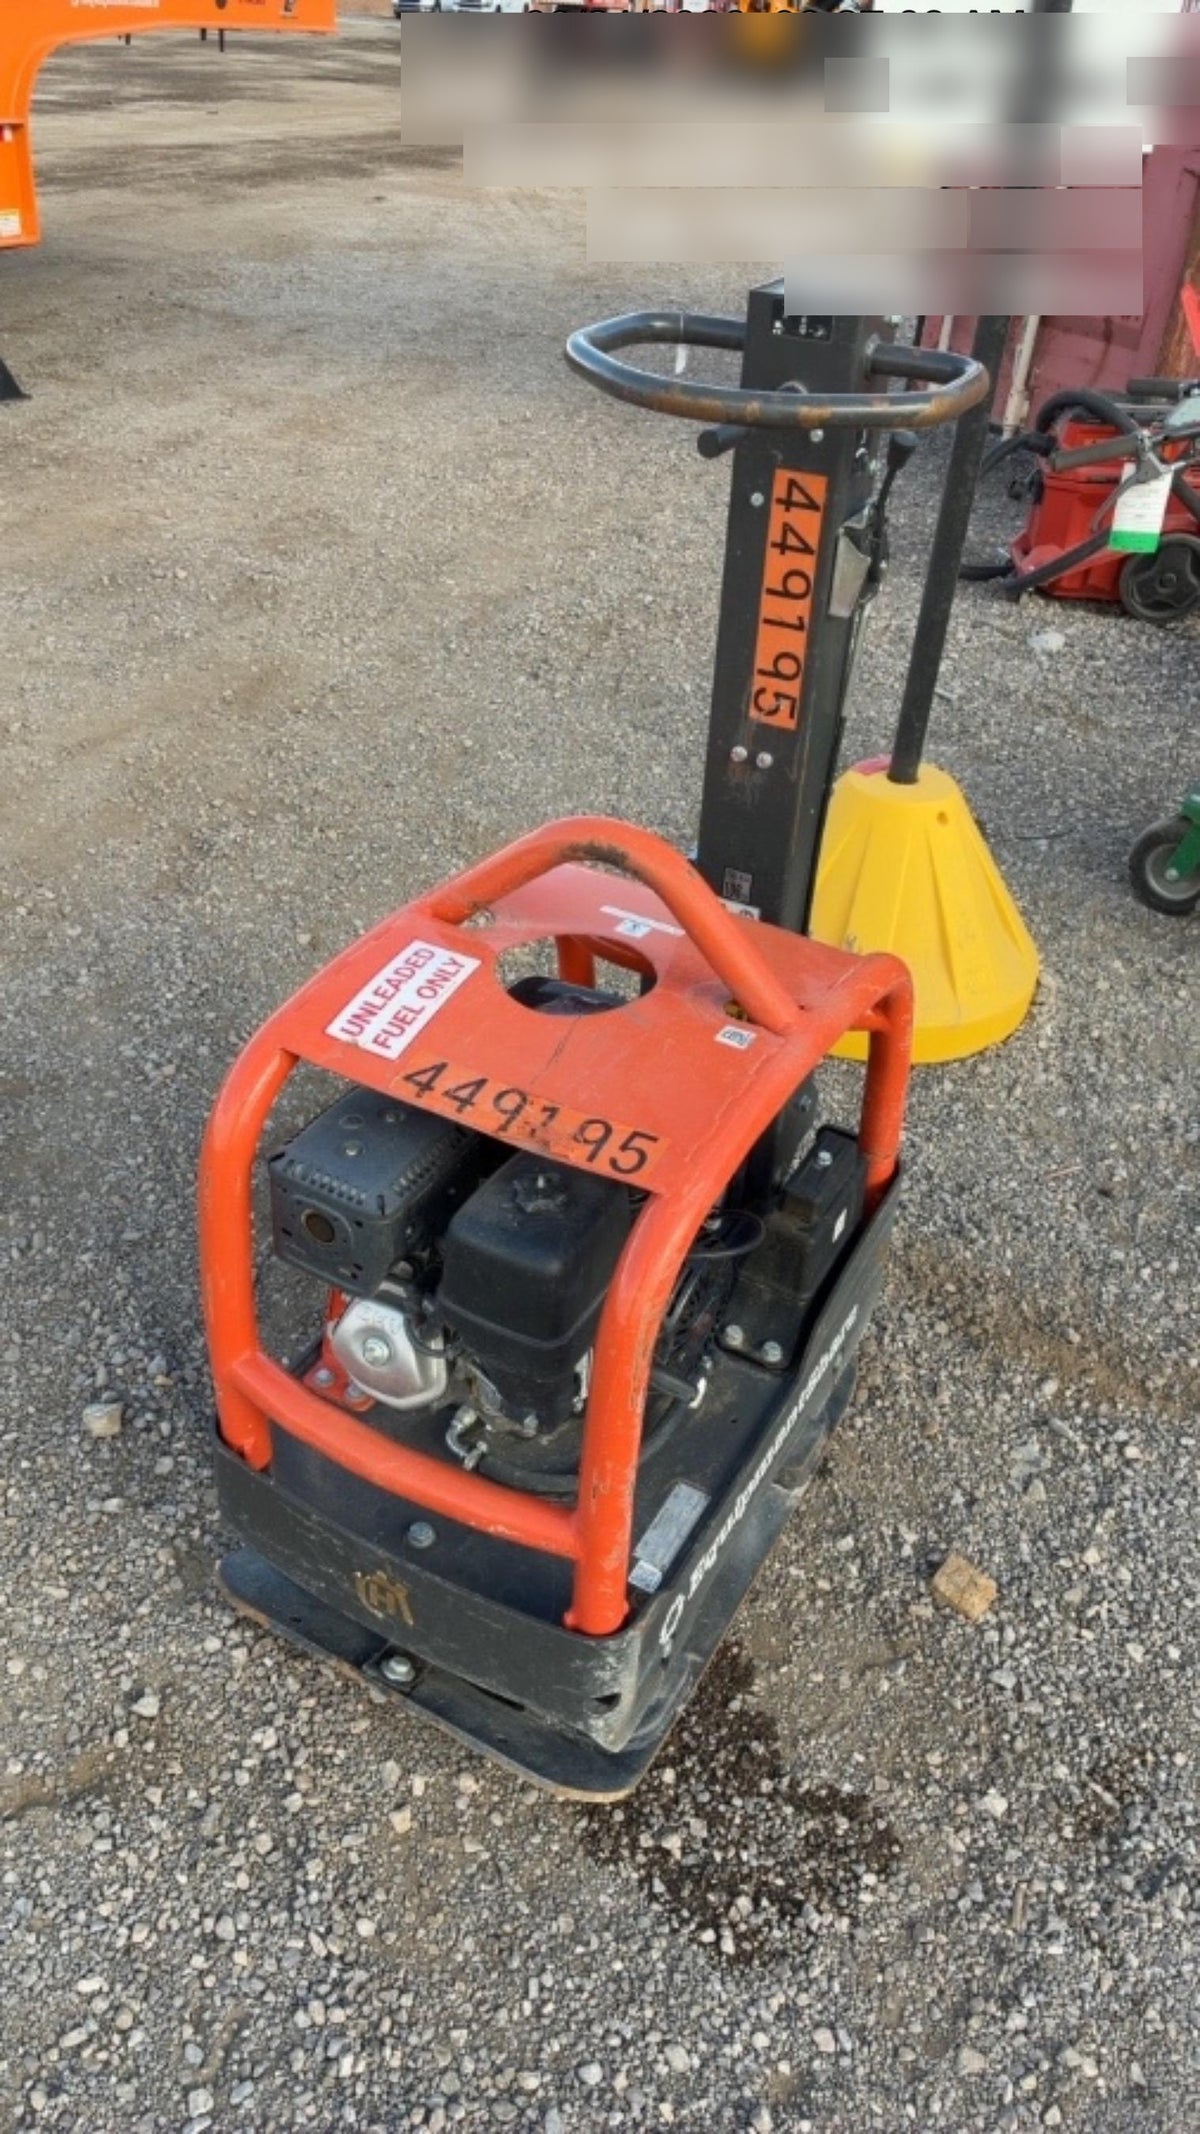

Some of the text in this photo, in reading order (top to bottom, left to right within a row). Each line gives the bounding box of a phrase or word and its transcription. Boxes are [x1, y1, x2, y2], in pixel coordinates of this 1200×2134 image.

[752, 477, 822, 720] 449195
[340, 947, 436, 1037] UNLEADED
[371, 957, 467, 1050] FUEL ONLY
[402, 1061, 659, 1175] 449195
